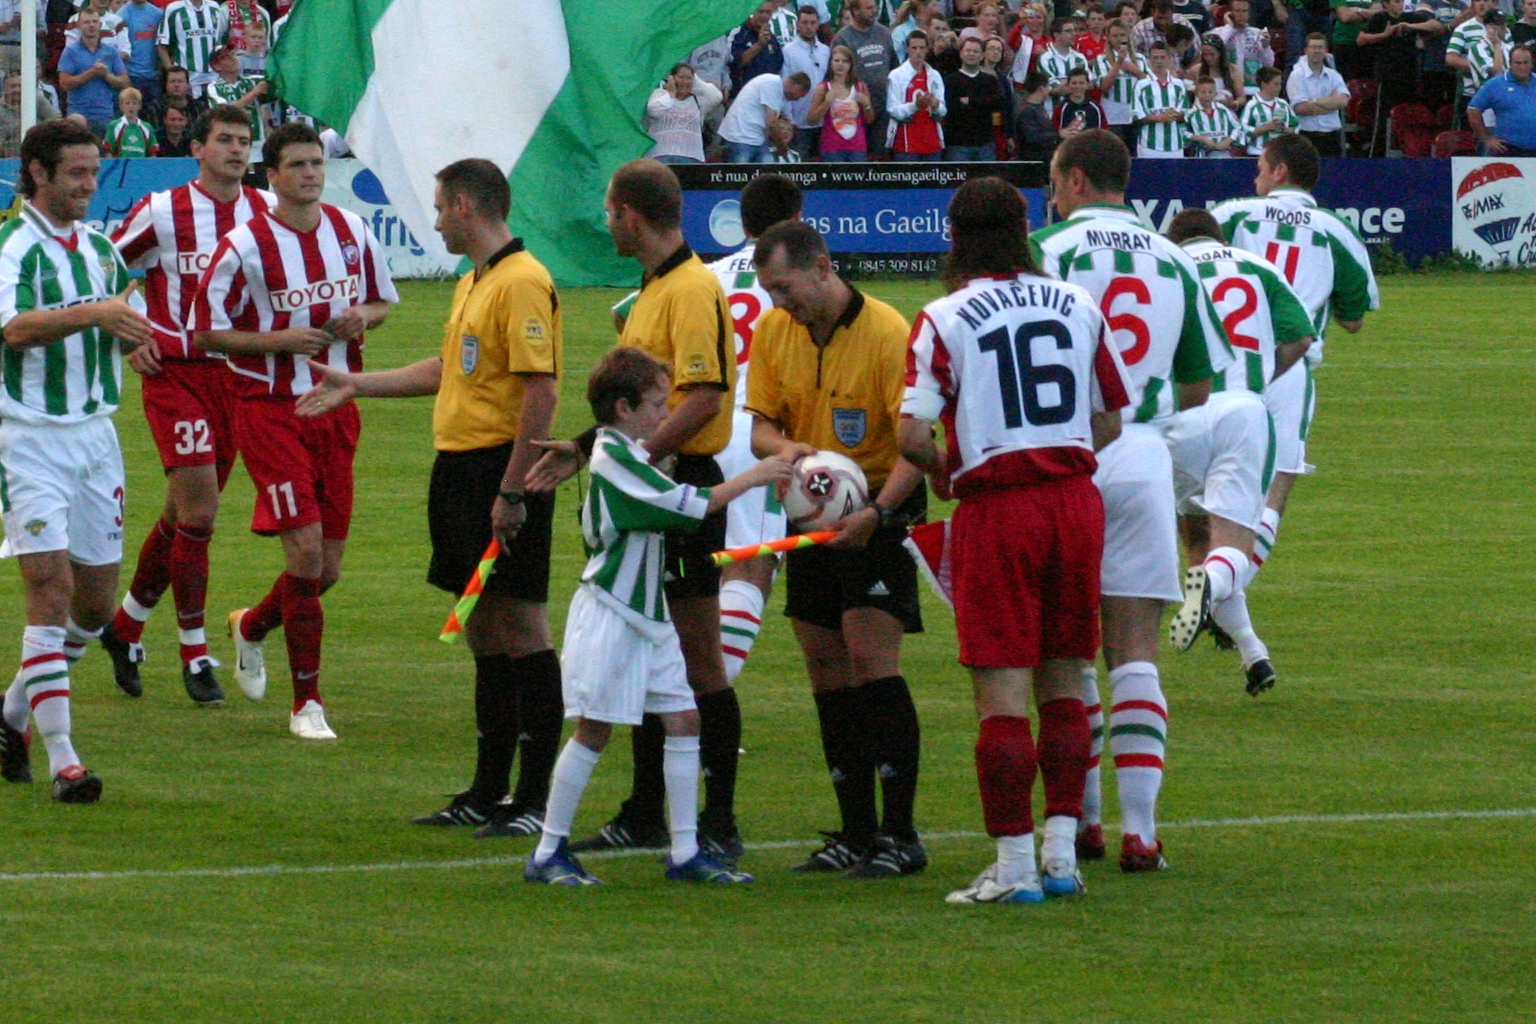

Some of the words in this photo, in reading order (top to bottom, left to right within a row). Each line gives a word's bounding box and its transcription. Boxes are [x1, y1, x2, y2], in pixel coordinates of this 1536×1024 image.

[726, 172, 748, 182] nua
[838, 215, 867, 234] na
[875, 208, 952, 242] Gaeilg
[1265, 205, 1311, 226] WOODS
[1086, 229, 1152, 251] MURRAY
[1265, 241, 1301, 287] 11
[272, 278, 361, 310] TOYOTA
[1100, 276, 1152, 366] 6
[1211, 276, 1259, 351] 2
[977, 319, 1076, 430] 16
[174, 419, 213, 455] 32
[267, 482, 299, 520] 11
